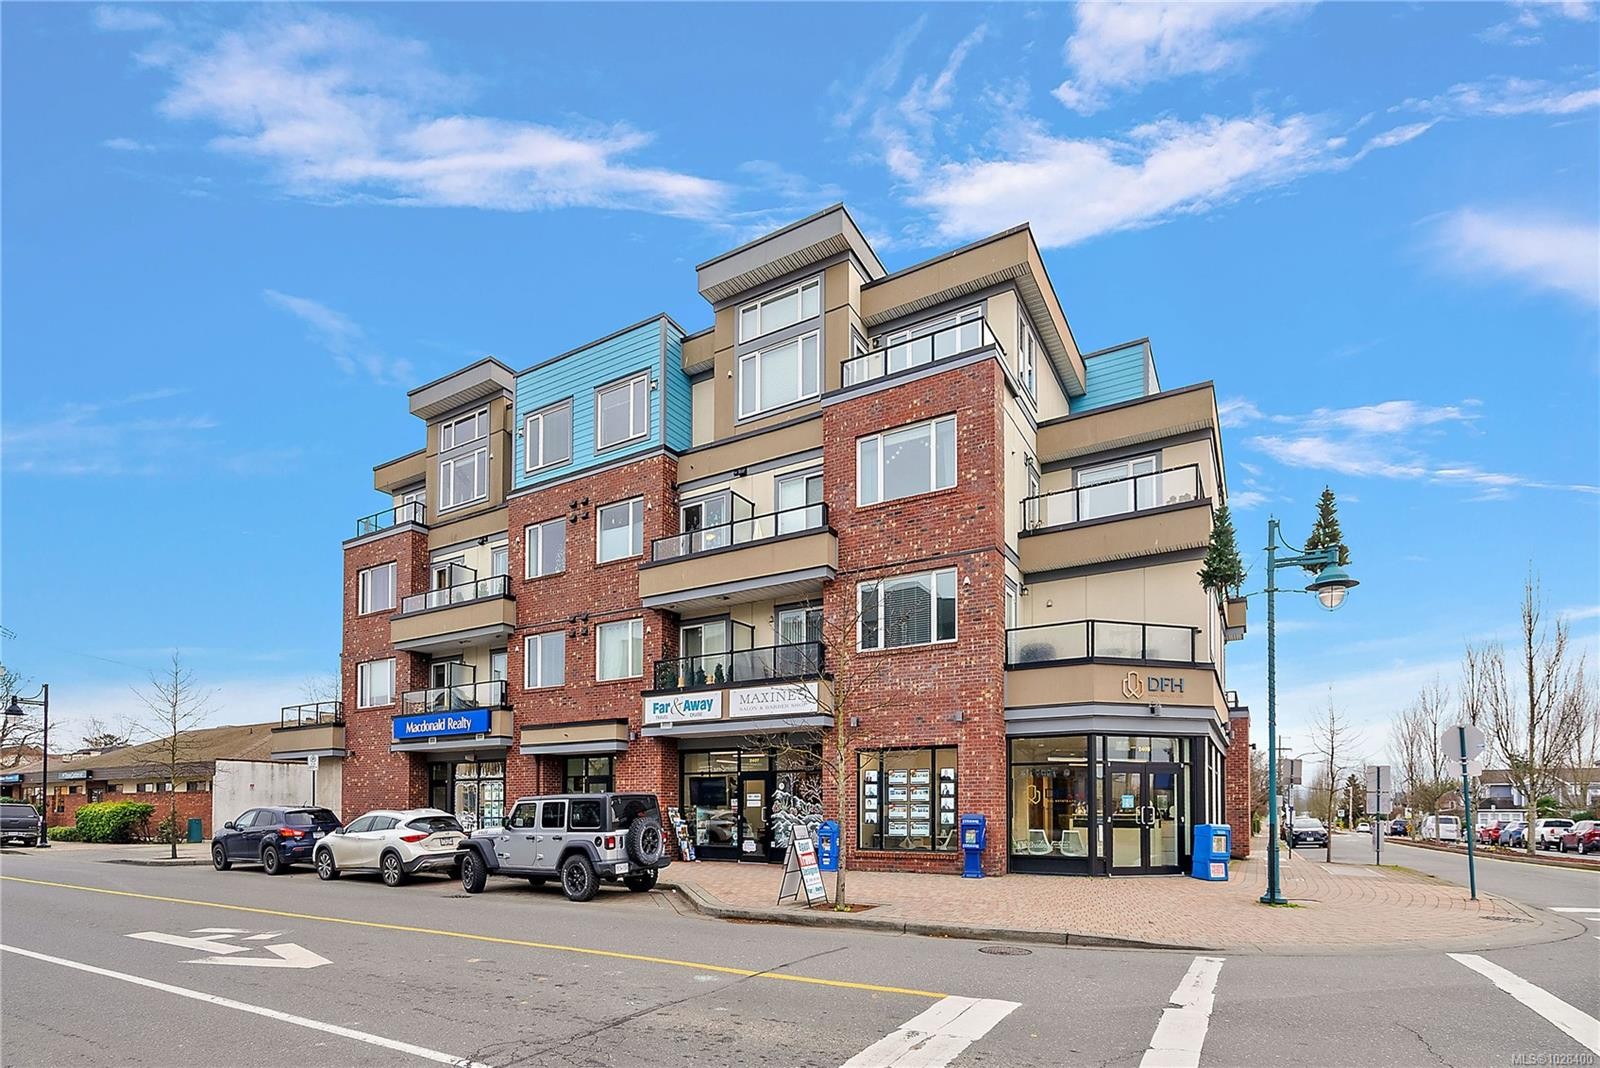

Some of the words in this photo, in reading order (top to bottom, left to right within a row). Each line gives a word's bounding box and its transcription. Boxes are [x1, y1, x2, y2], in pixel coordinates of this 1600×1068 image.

[1147, 676, 1184, 693] DFH
[652, 702, 670, 714] Far
[670, 697, 685, 717] &
[682, 698, 713, 712] Away
[406, 718, 445, 733] Macdonald
[447, 716, 471, 731] Realty
